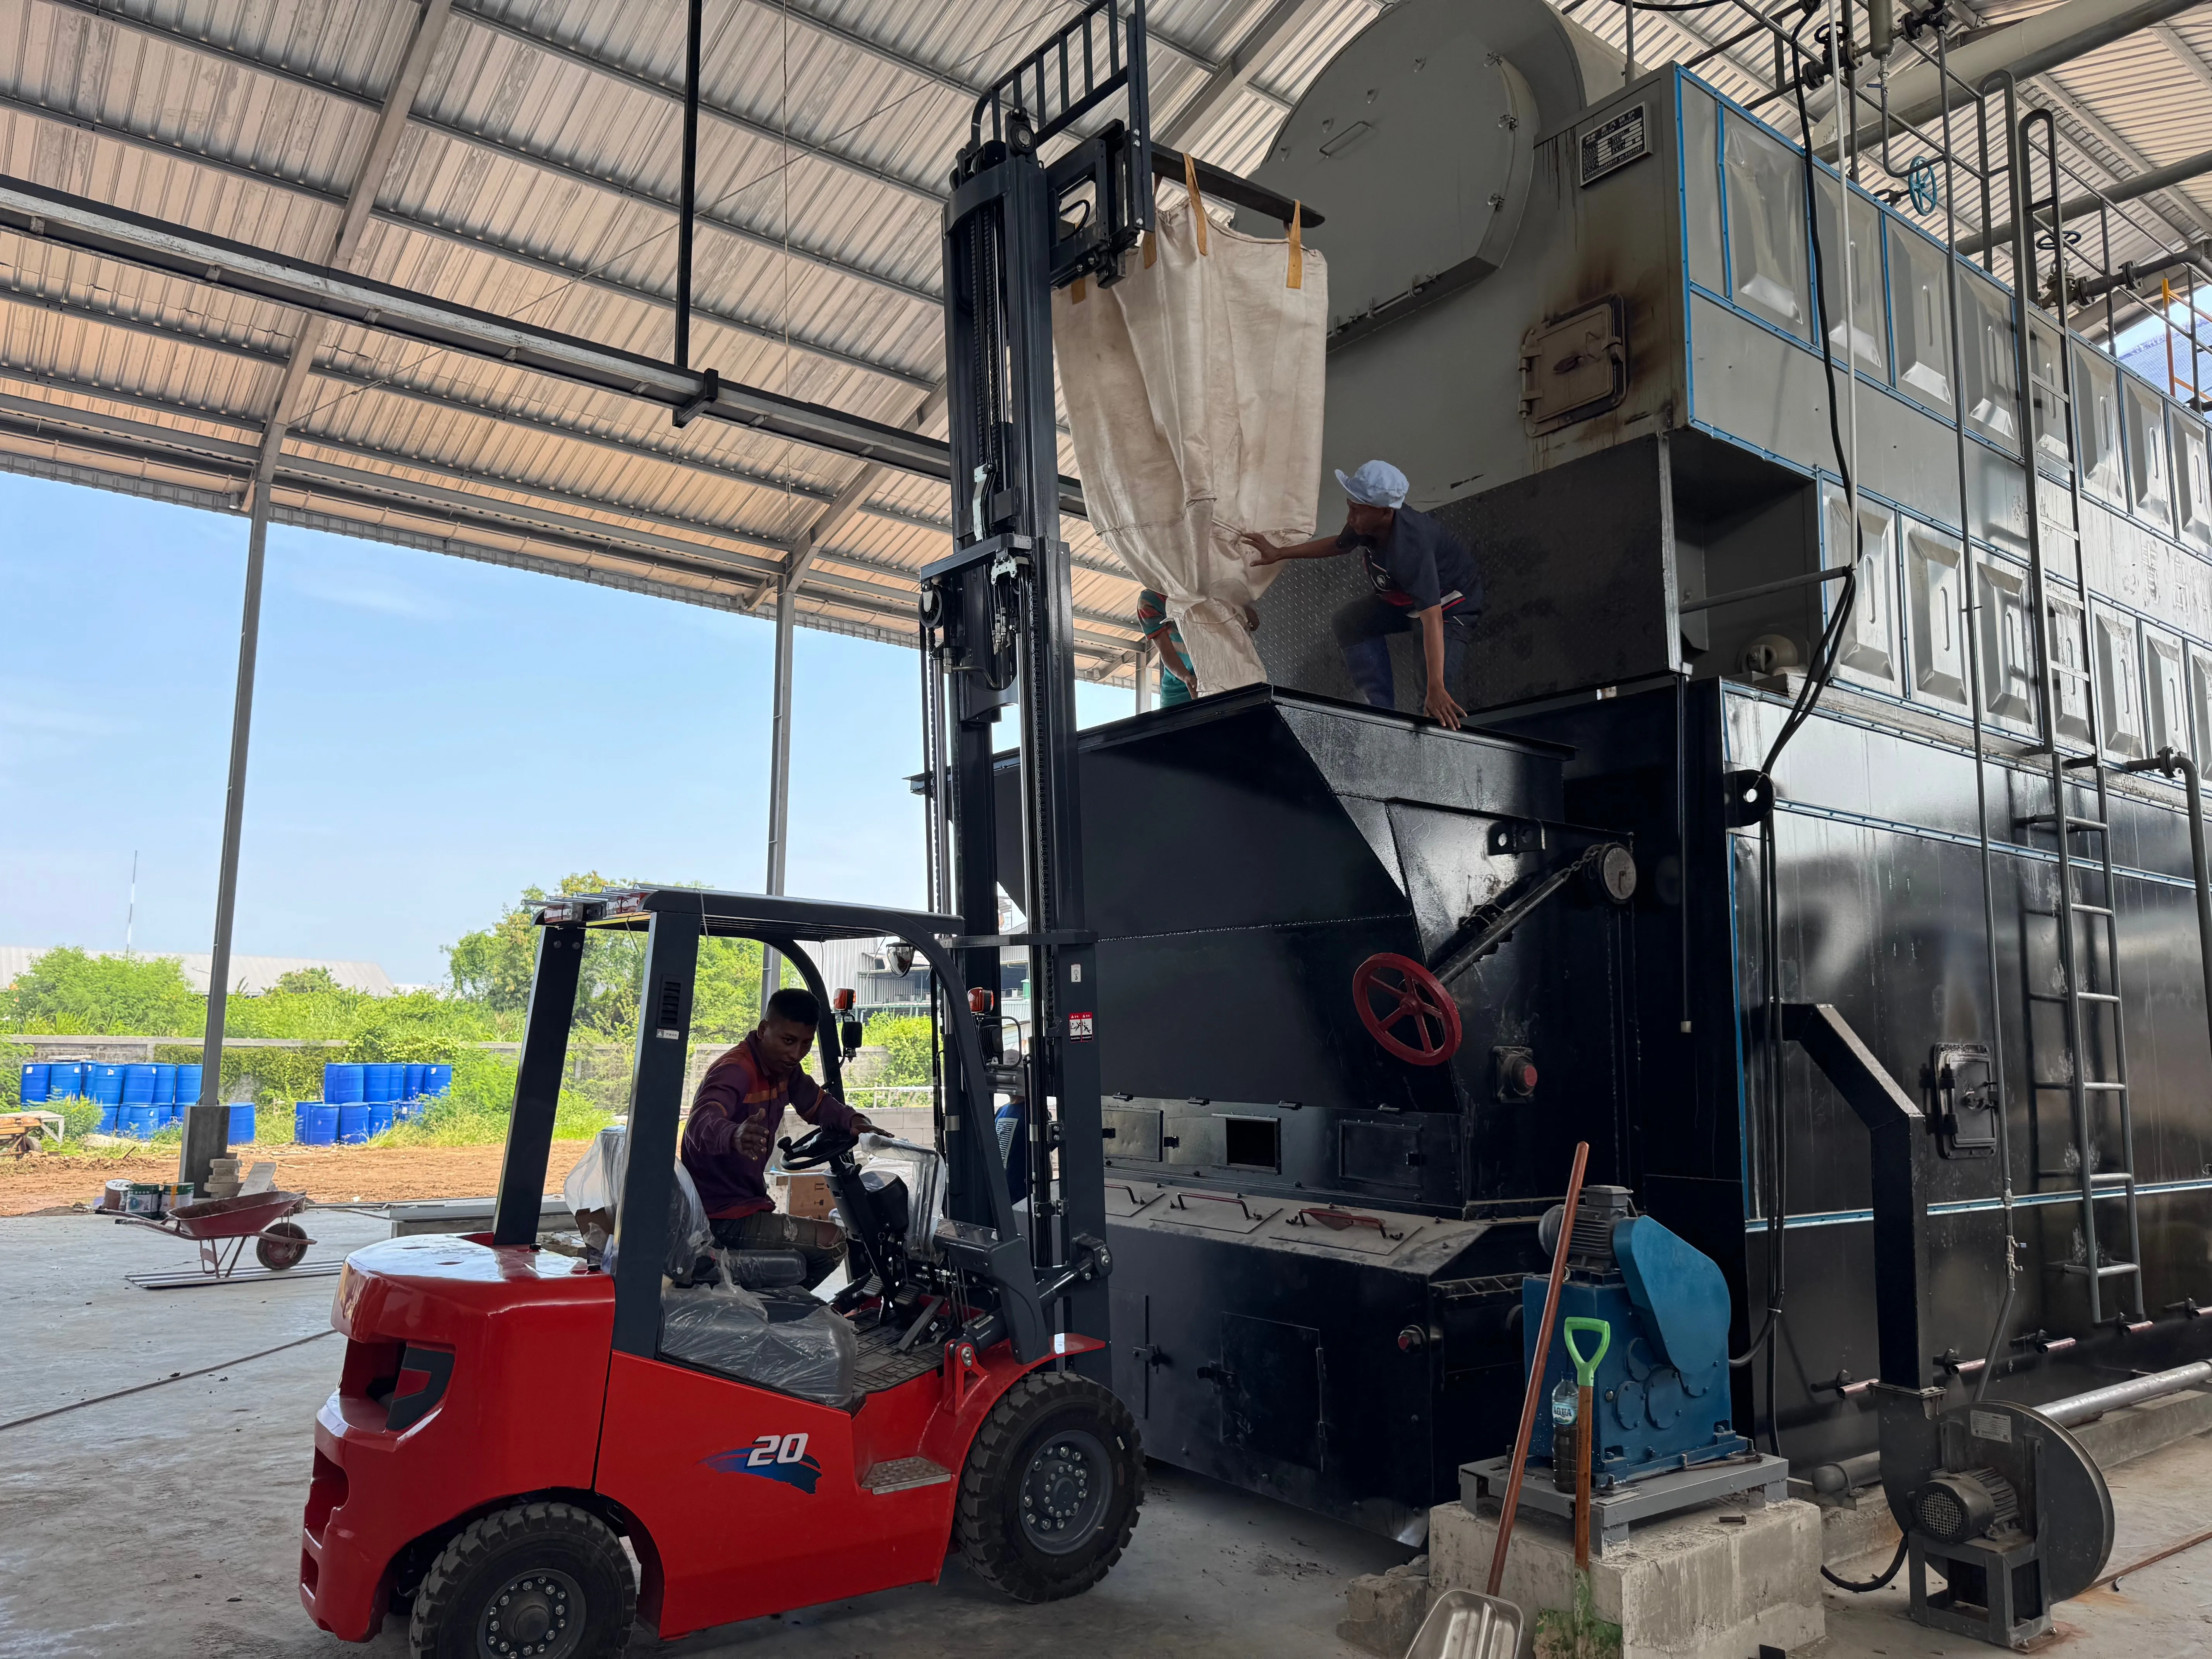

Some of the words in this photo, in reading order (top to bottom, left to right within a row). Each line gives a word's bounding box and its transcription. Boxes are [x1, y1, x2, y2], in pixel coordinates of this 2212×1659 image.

[1620, 117, 1635, 127] BOILER
[1554, 1406, 1572, 1417] AQUA
[747, 1433, 808, 1466] 20
